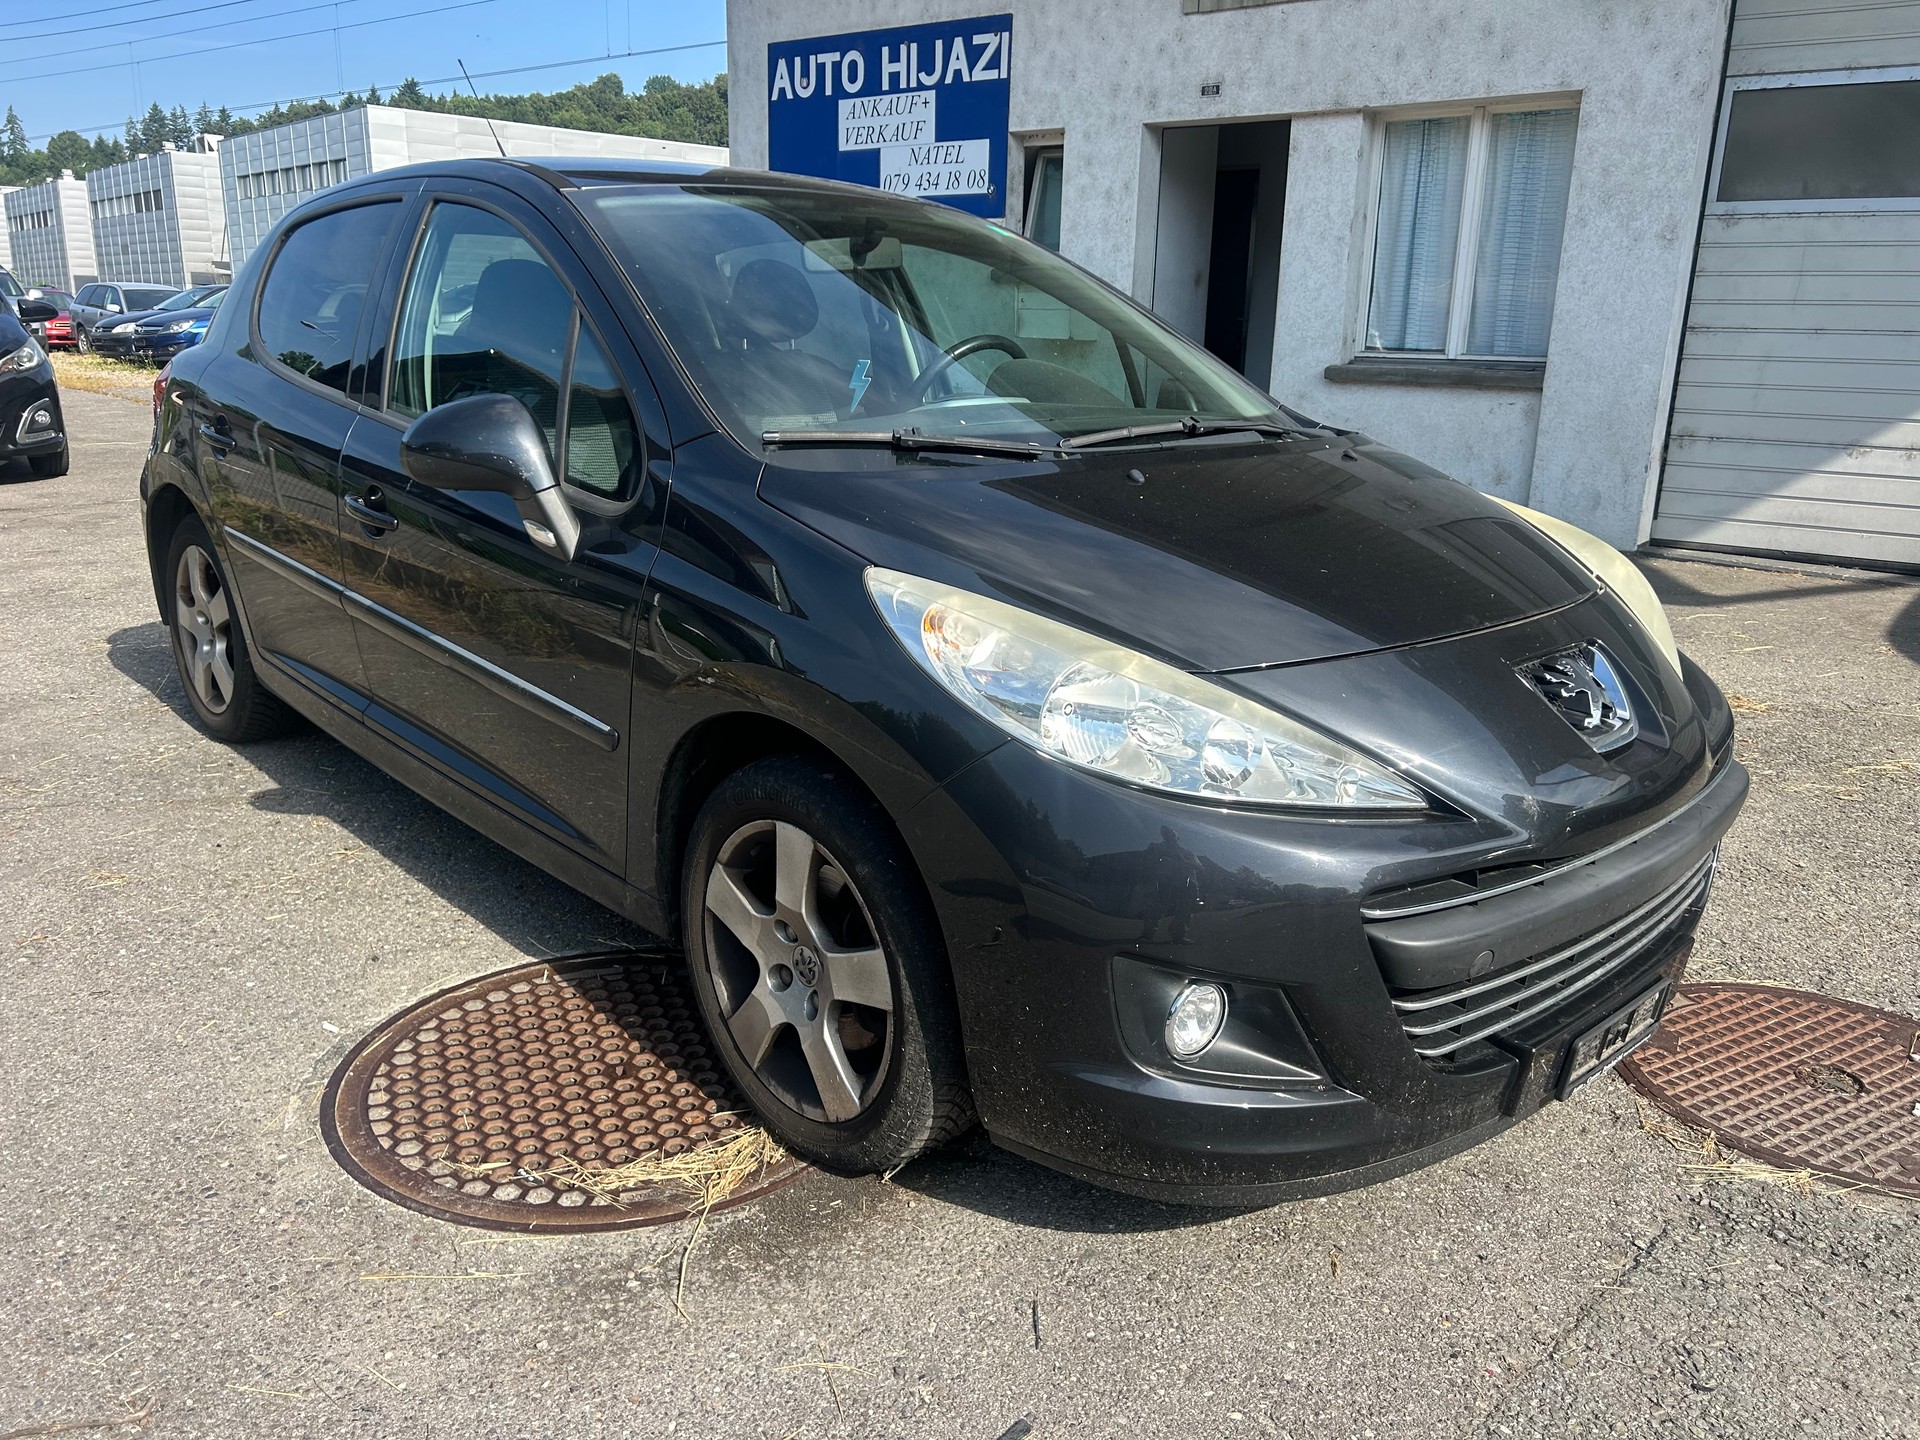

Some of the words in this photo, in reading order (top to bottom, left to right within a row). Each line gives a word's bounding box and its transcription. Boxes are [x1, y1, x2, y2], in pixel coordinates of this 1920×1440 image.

[771, 50, 864, 101] AUTO
[881, 31, 1009, 91] HIJAZI
[845, 120, 926, 146] VERKAUF
[908, 145, 965, 166] NATEL
[884, 173, 910, 192] 079
[915, 171, 940, 191] 434
[946, 170, 961, 190] 18
[967, 169, 986, 189] 08
